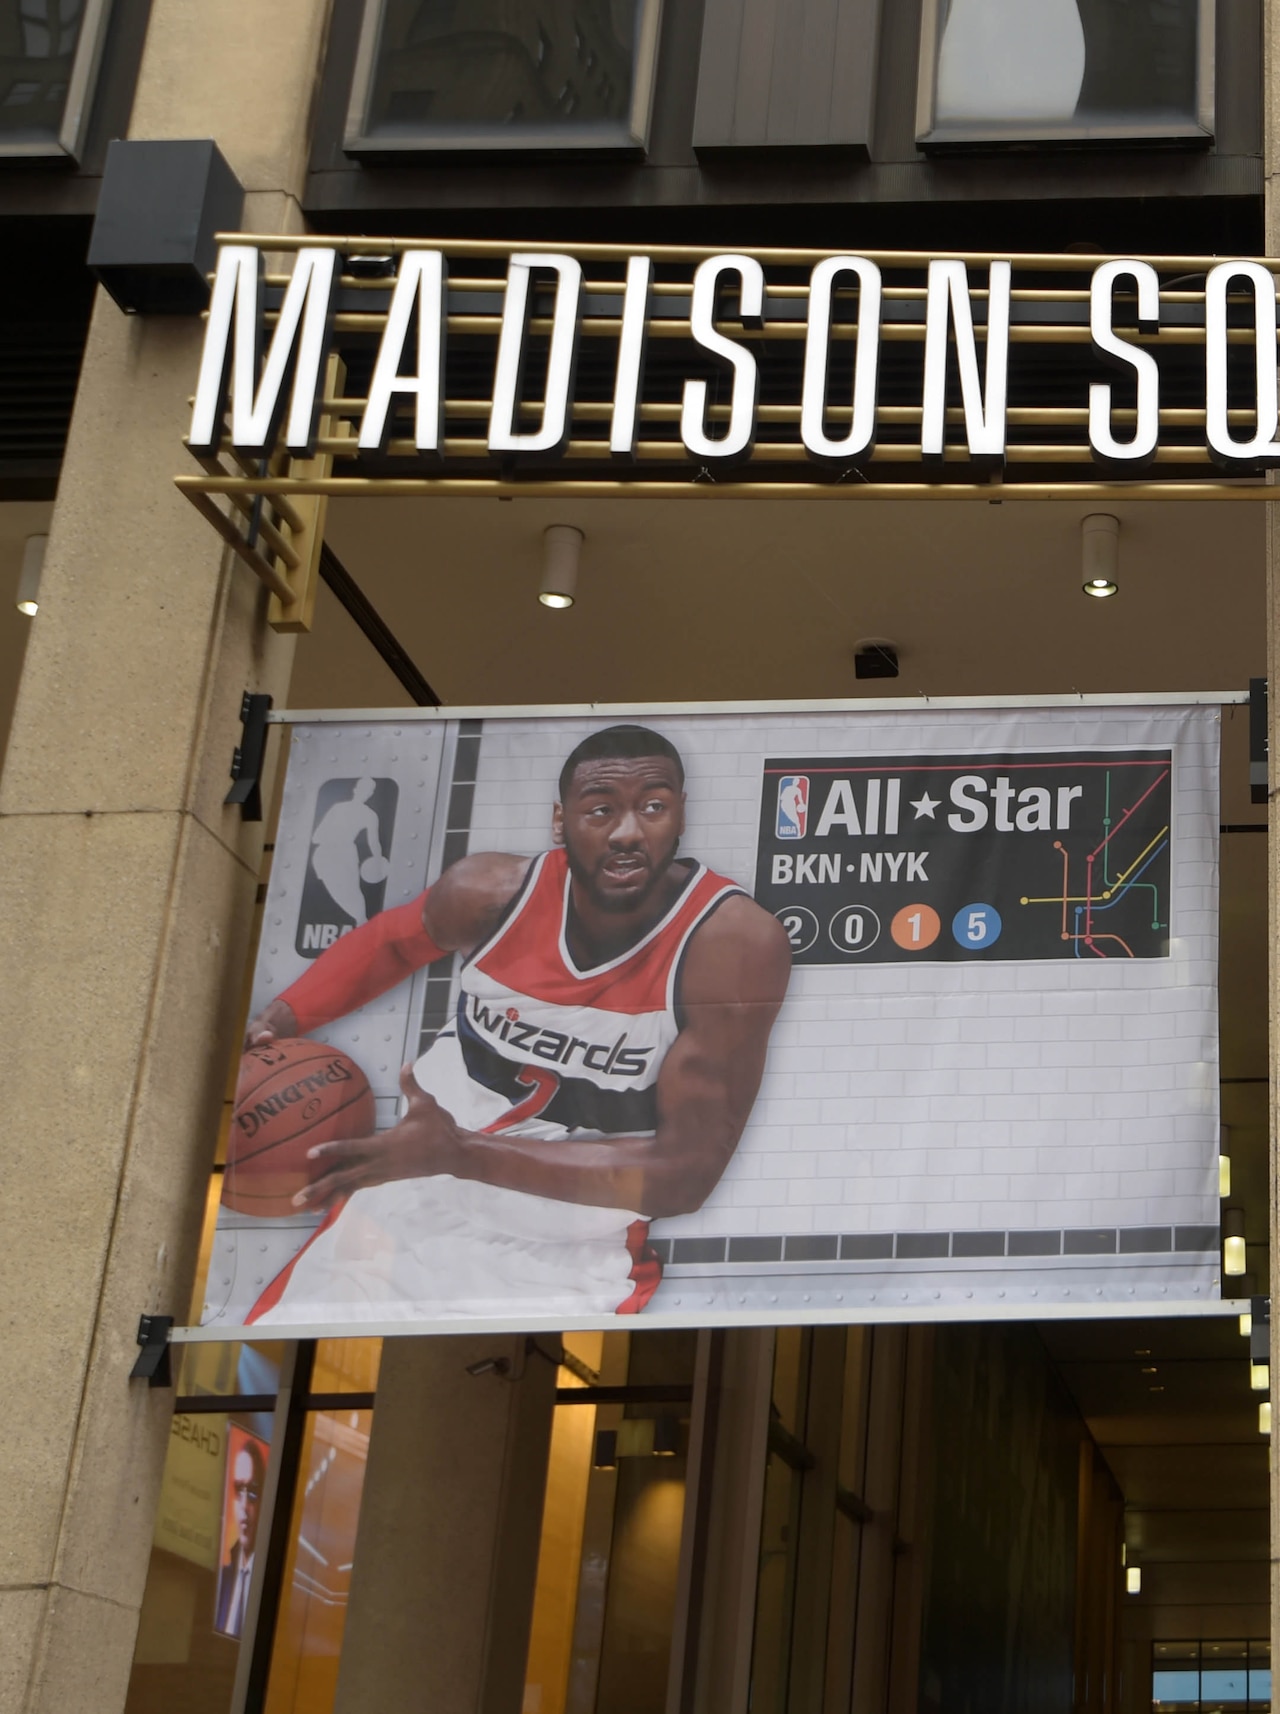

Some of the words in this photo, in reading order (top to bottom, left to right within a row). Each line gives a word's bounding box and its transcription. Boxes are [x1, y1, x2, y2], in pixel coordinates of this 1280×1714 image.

[188, 246, 1012, 460] MADISON
[779, 825, 797, 835] NBA
[814, 777, 901, 836] All
[947, 775, 1083, 832] Star
[236, 1058, 353, 1139] SPALDING
